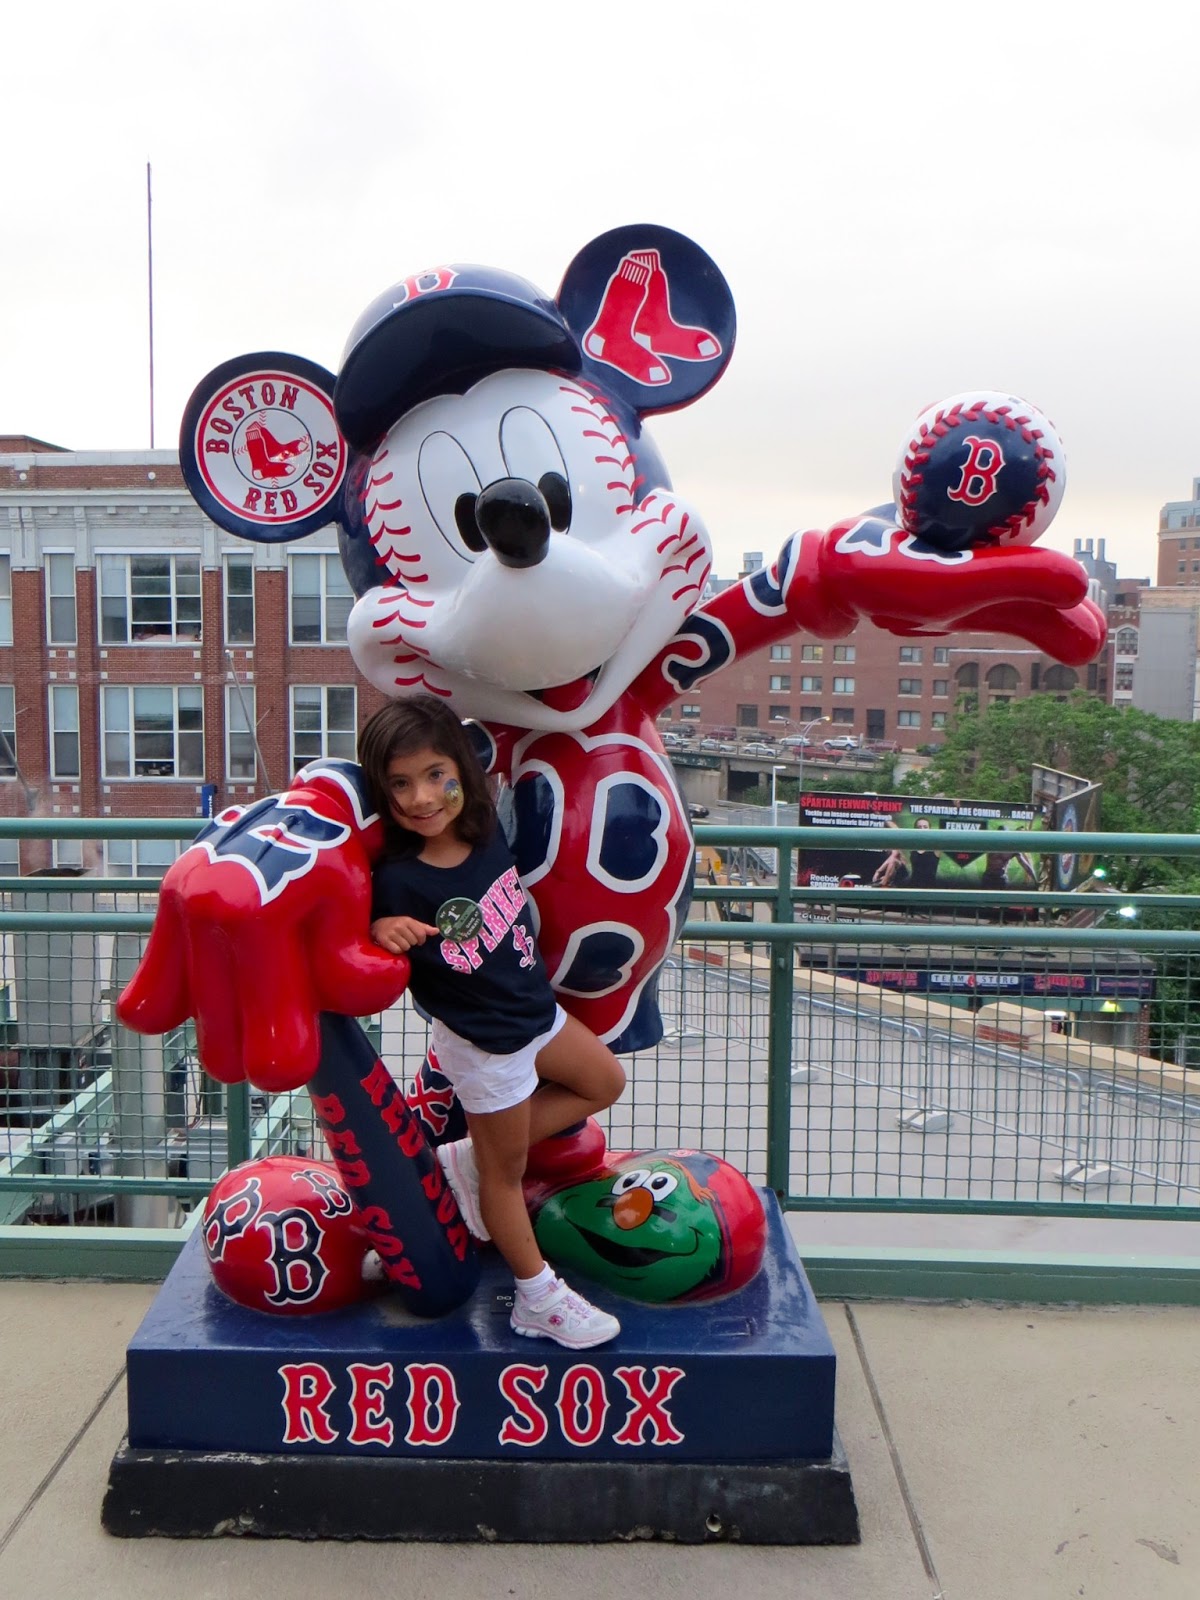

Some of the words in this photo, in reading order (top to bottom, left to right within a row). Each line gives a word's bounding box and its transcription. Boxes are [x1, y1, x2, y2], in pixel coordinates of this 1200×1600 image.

[206, 382, 299, 454] BOSTON
[243, 487, 298, 515] RED
[303, 441, 337, 496] SOX
[947, 435, 1006, 506] B
[801, 796, 837, 808] SPARTAN
[838, 798, 869, 810] FENWAY
[872, 800, 902, 811] SPRINT
[910, 804, 923, 813] THE
[923, 805, 957, 815] SPARTANS
[958, 807, 972, 816] ARE
[810, 873, 839, 883] Reebok
[291, 1169, 352, 1218] B
[255, 1207, 331, 1306] B
[278, 1362, 461, 1447] RED
[498, 1363, 686, 1447] SOX
